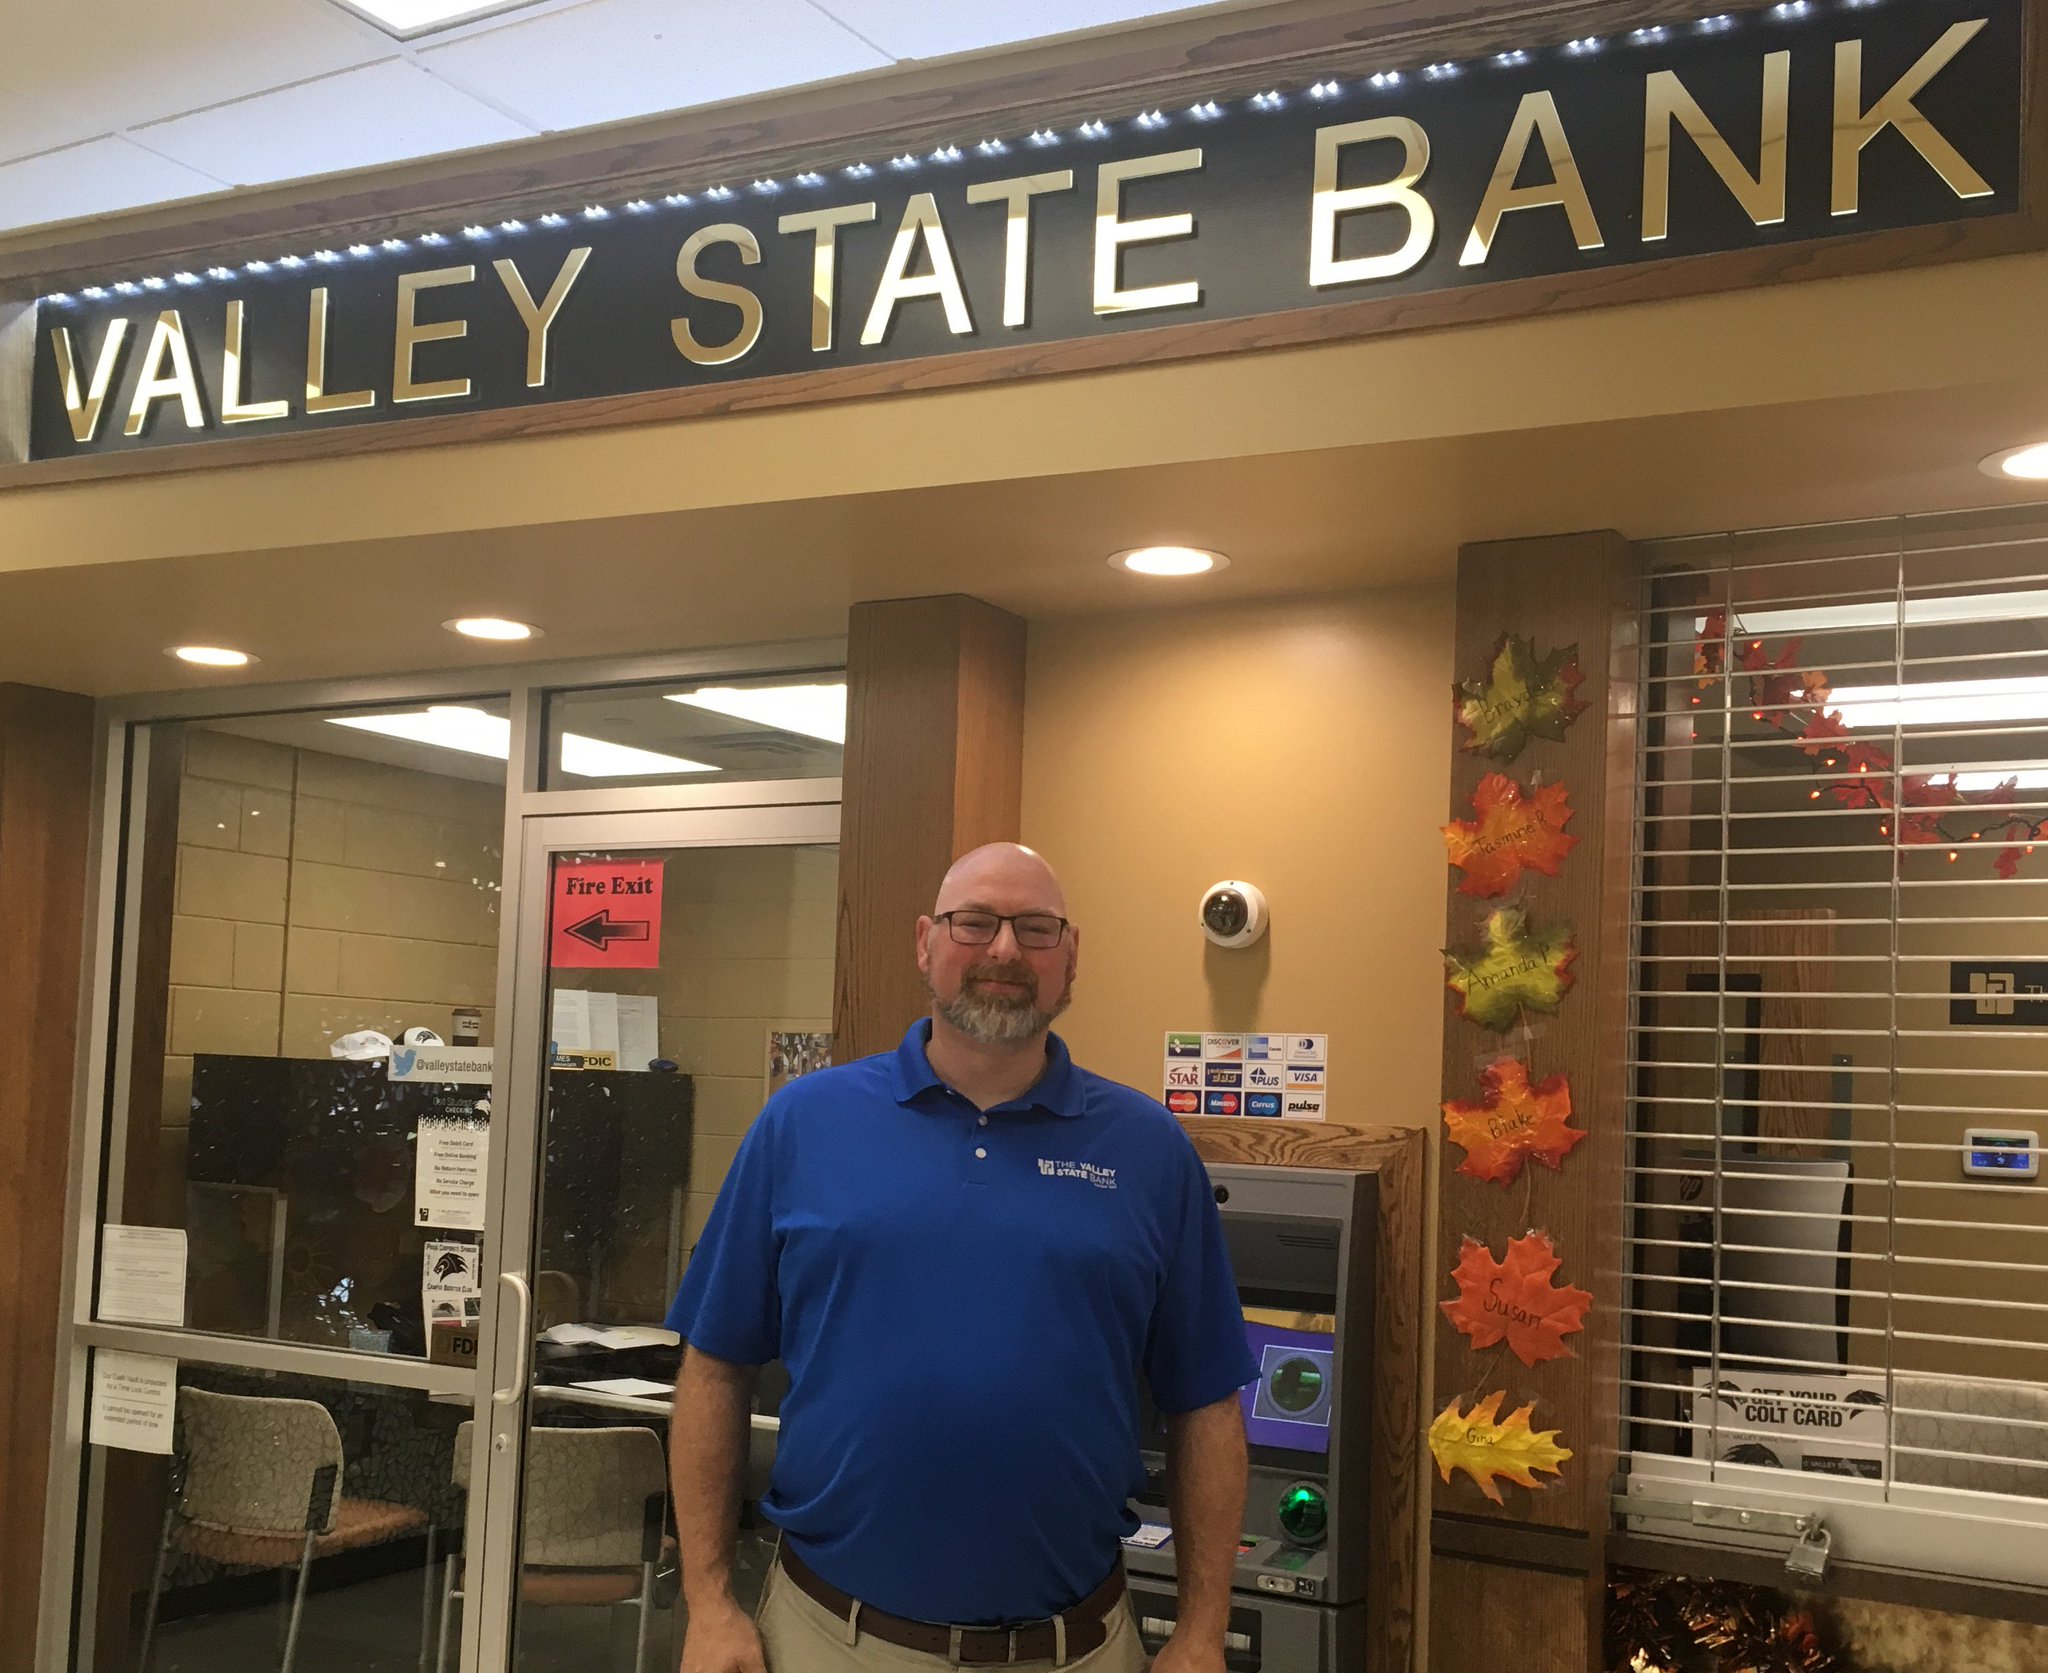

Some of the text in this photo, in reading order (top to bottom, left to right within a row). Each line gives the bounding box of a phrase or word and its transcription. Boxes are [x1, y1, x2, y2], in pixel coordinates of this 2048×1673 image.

[50, 17, 1995, 443] VALLEY STATE BANK
[566, 876, 654, 896] Fire Exit
[1467, 955, 1538, 996] Amanda
[1207, 1038, 1241, 1046] DISCOVER
[416, 1058, 493, 1074] @valleystatebank
[583, 1056, 612, 1067] FDIC
[1168, 1072, 1199, 1085] STAR
[1256, 1076, 1280, 1087] PLUS
[1294, 1072, 1318, 1082] VISA
[1210, 1099, 1236, 1108] Maestro
[1251, 1100, 1275, 1110] Cirrus
[1288, 1099, 1321, 1112] pulse
[1055, 1160, 1117, 1177] THE VALLEY
[1056, 1168, 1088, 1179] STATE
[1089, 1173, 1116, 1186] BANK
[1483, 1277, 1542, 1331] Susan
[453, 1337, 478, 1355] FDI
[1751, 1387, 1837, 1410] GET YOUR
[1745, 1404, 1843, 1428] COLT CARD
[1466, 1427, 1494, 1446] Gina
